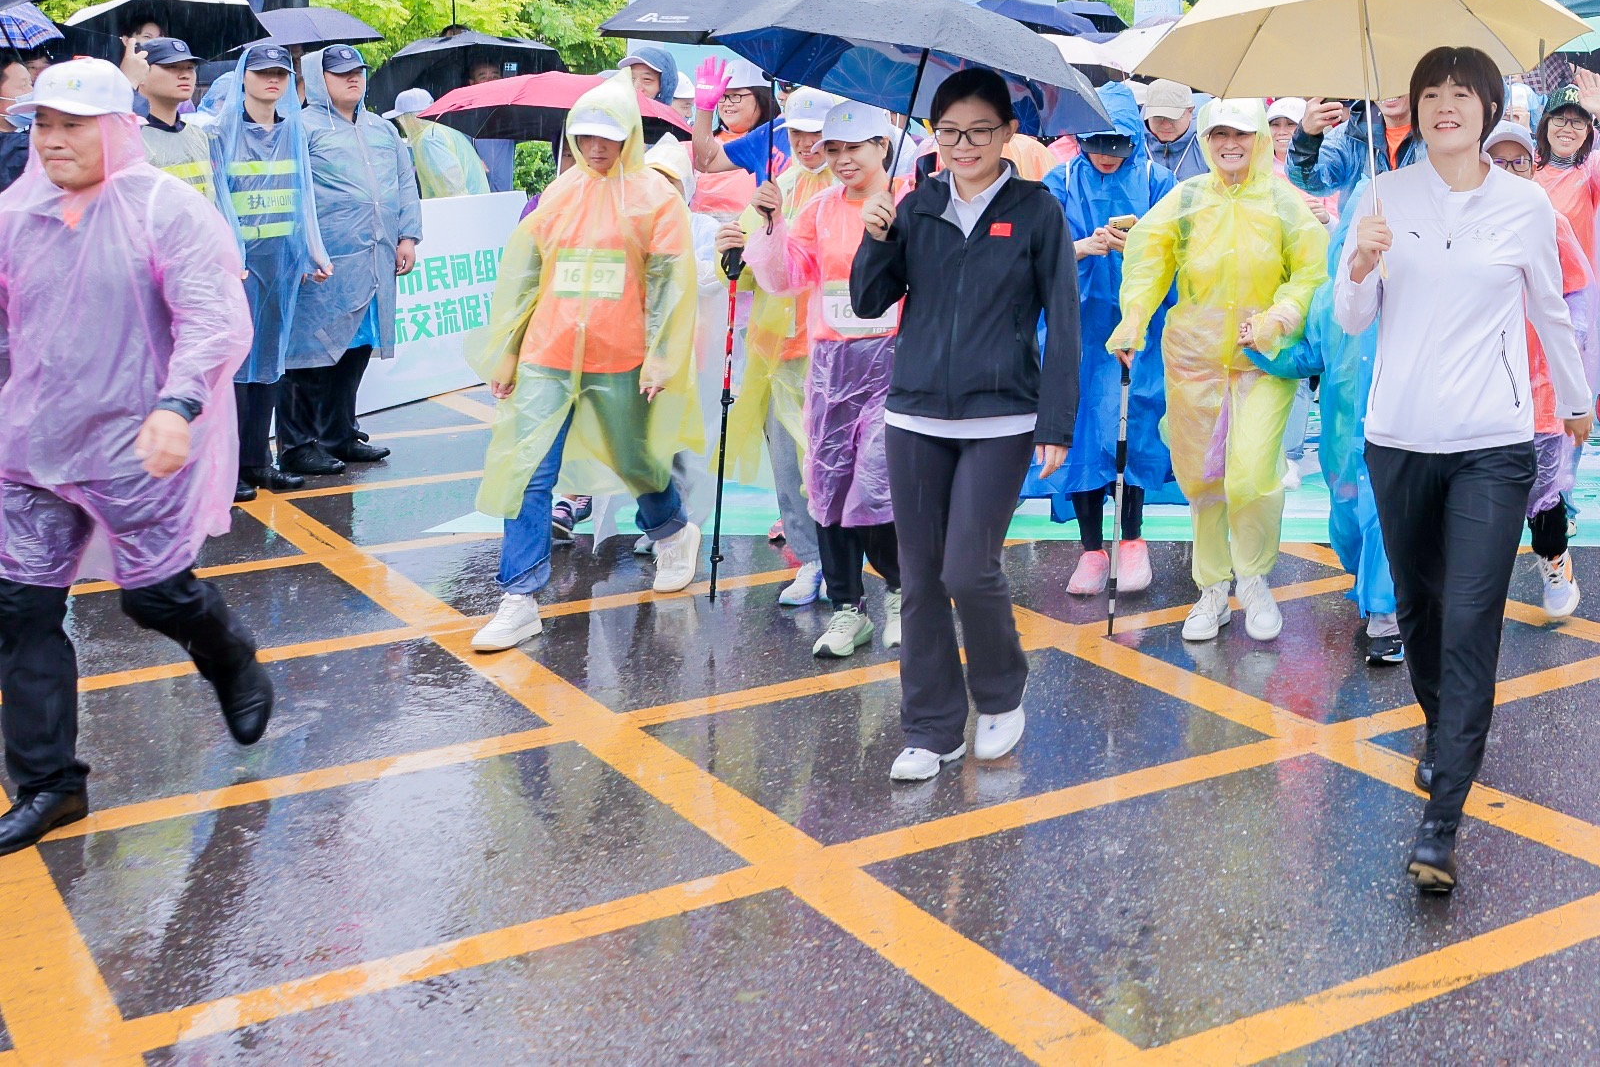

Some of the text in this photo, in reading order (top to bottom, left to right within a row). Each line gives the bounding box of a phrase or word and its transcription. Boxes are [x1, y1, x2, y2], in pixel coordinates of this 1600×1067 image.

[399, 247, 503, 295] 市民间组
[562, 268, 616, 284] 1697
